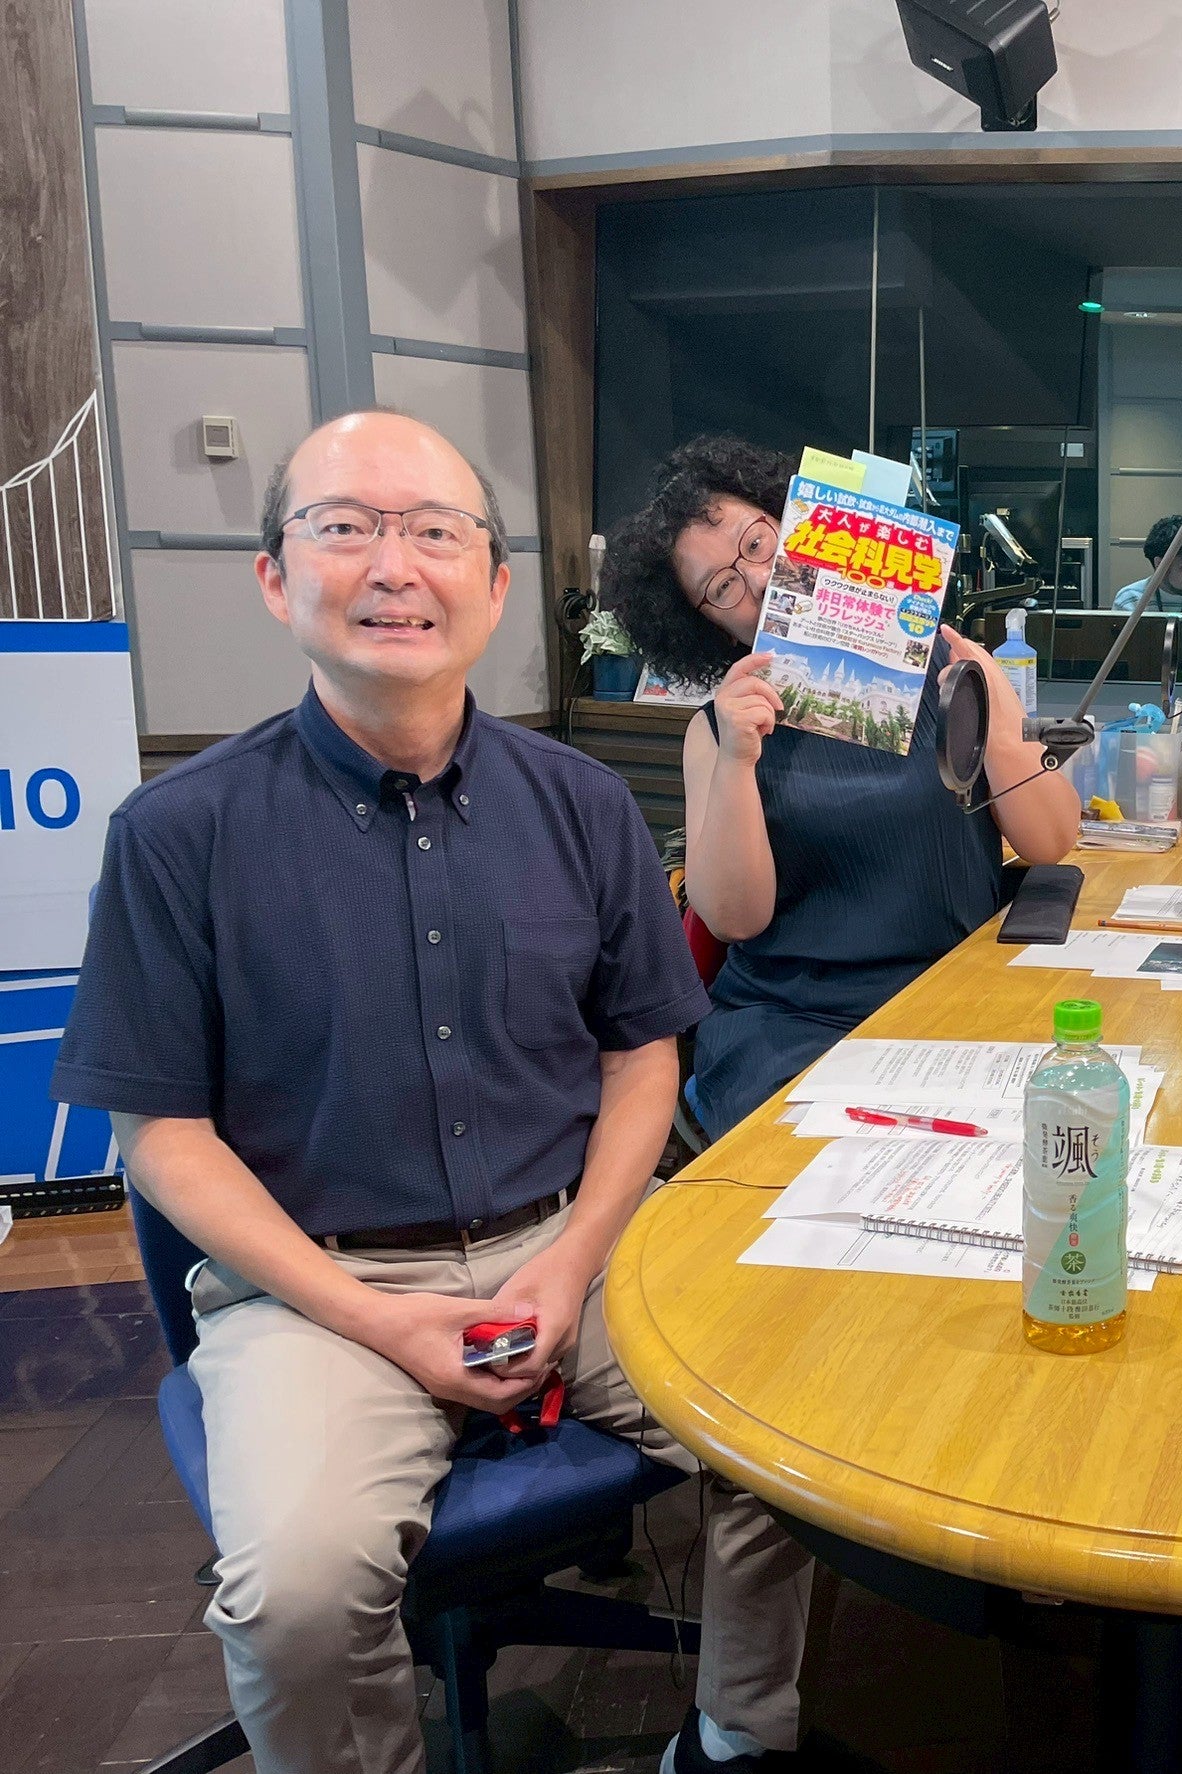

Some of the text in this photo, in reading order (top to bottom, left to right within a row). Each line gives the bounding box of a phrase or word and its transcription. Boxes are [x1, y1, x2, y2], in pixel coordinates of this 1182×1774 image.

[817, 508, 929, 551] 大人が楽しむ
[784, 519, 943, 591] 社会科見学
[816, 588, 895, 620] 非日常体験で
[818, 602, 886, 631] リフレッシュ
[1052, 1125, 1098, 1179] 颯
[1091, 1134, 1099, 1162] そう
[1069, 1194, 1078, 1231] 香る爽快
[1065, 1253, 1084, 1272] 茶
